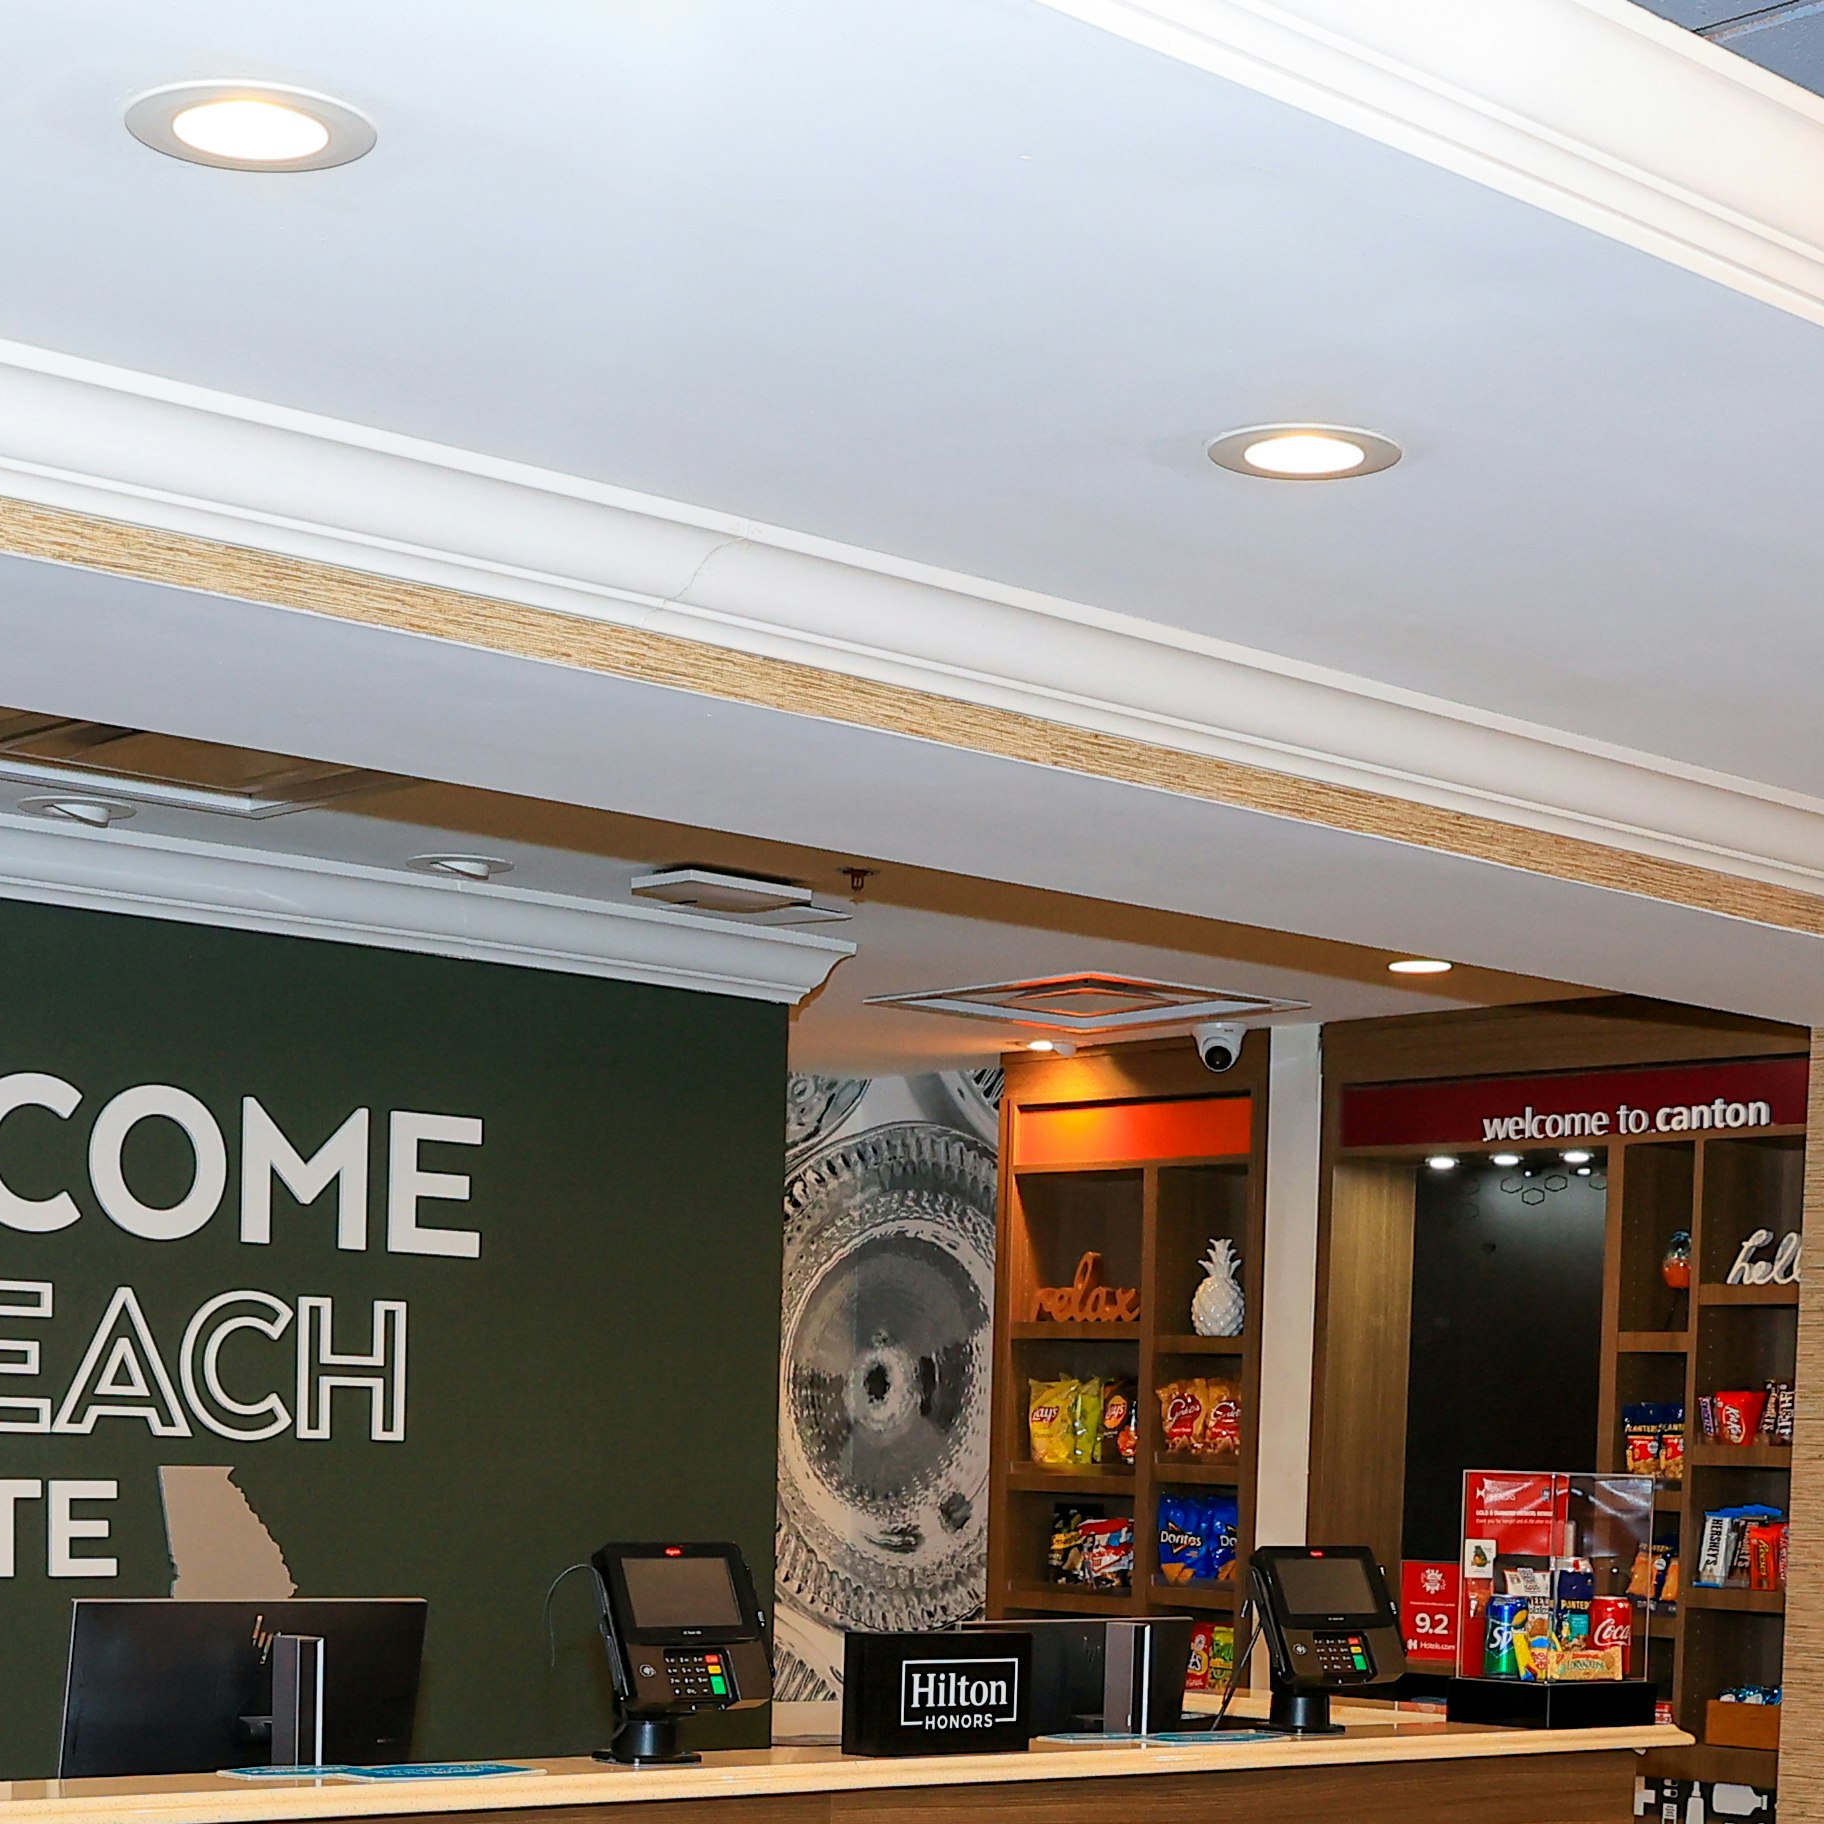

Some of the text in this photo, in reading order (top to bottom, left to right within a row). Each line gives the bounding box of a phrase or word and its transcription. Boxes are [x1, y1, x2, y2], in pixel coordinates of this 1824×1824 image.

[1483, 1098, 1770, 1142] welcome to canton
[1030, 1251, 1140, 1322] relax
[1160, 1530, 1202, 1548] Doritos
[1706, 1519, 1723, 1566] HERSHEY'S
[1415, 1612, 1449, 1635] 9.2
[910, 1672, 1008, 1708] Hilton
[925, 1713, 993, 1730] HONORS
